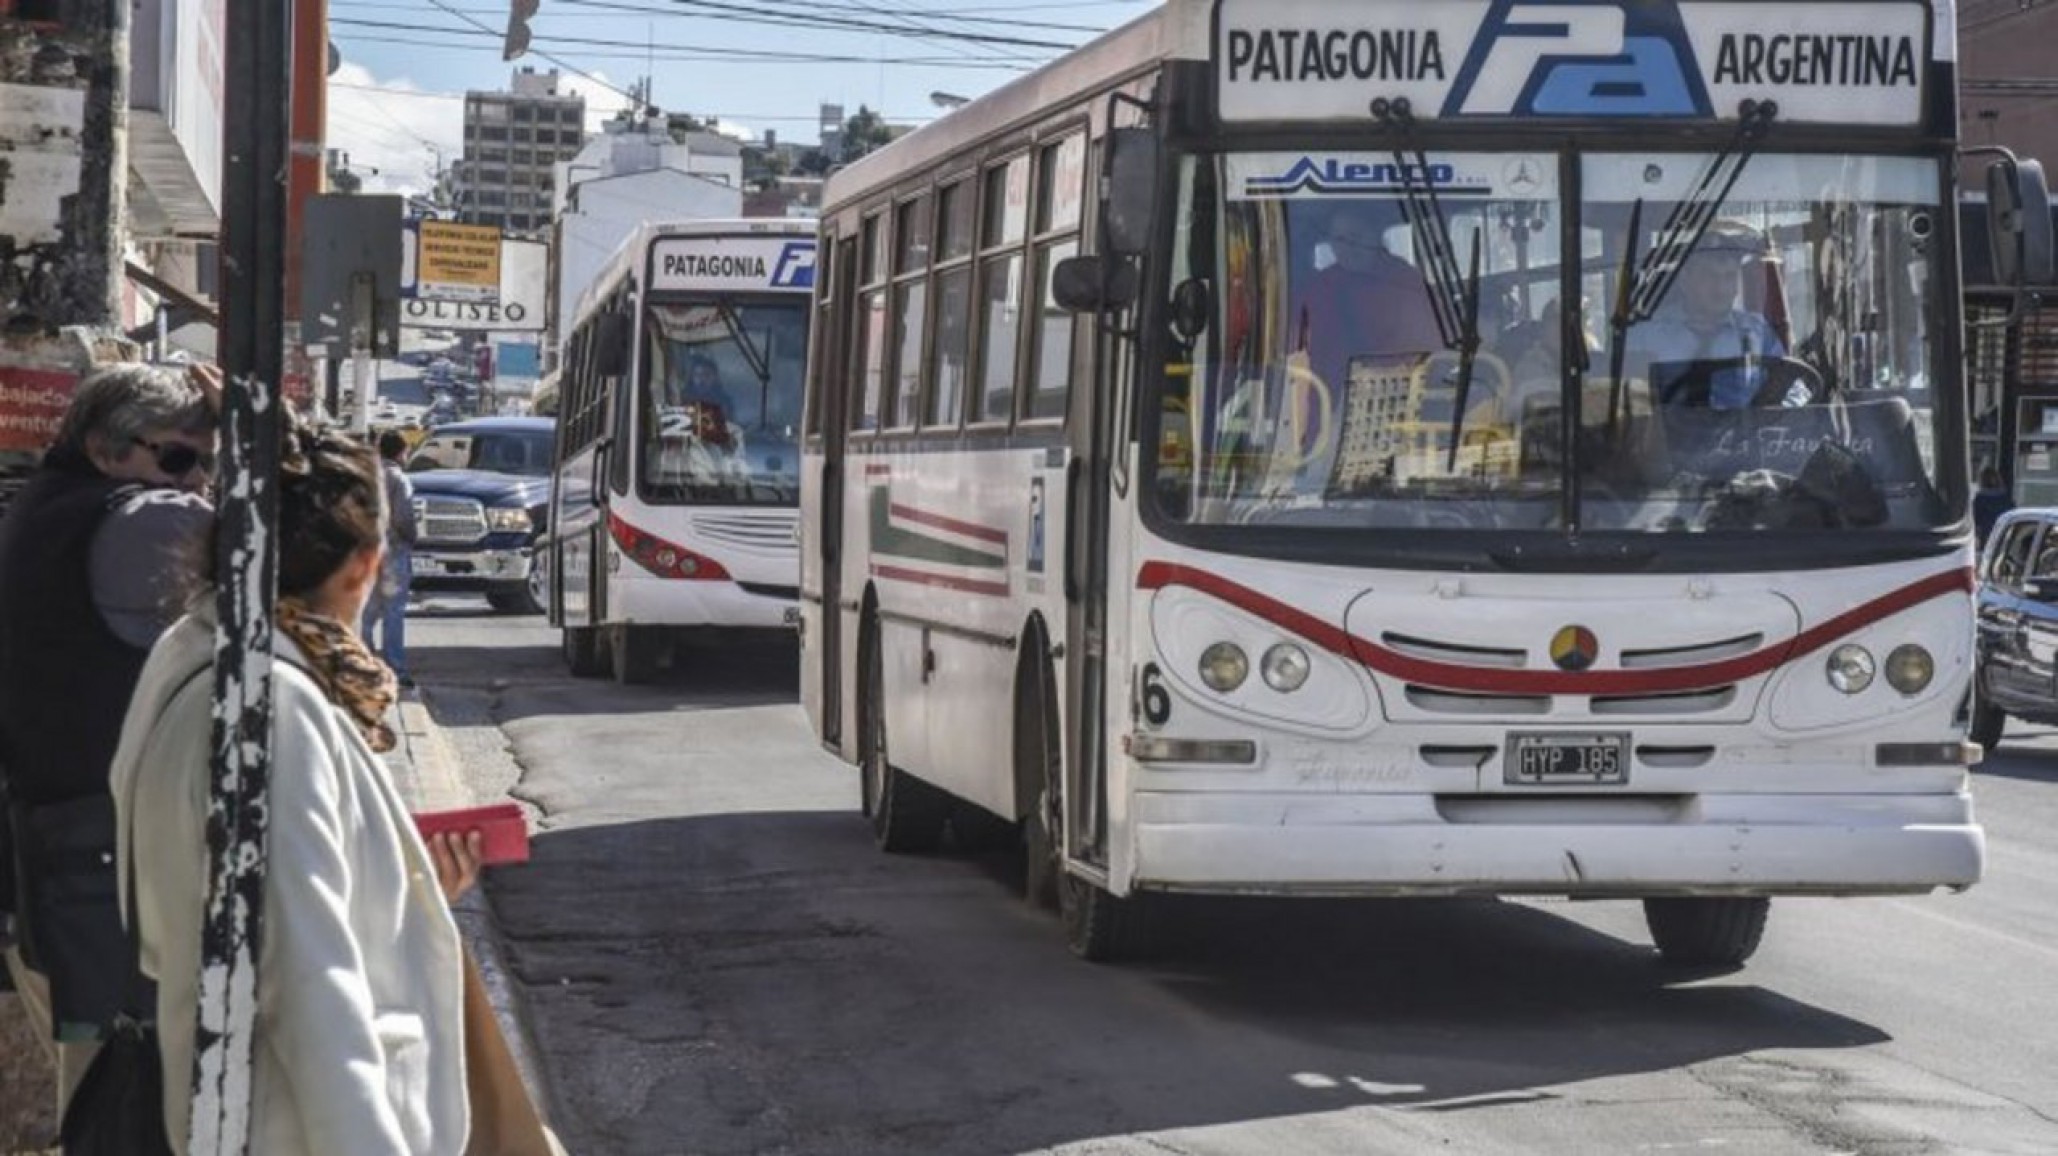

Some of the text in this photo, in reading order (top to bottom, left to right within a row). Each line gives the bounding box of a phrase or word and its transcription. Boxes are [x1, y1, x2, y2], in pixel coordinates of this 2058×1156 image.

[1229, 29, 1445, 82] PATAGONIA
[1713, 33, 1917, 87] ARGENTINA
[664, 255, 766, 277] PATAGONIA
[1523, 748, 1617, 773] HYP 185
